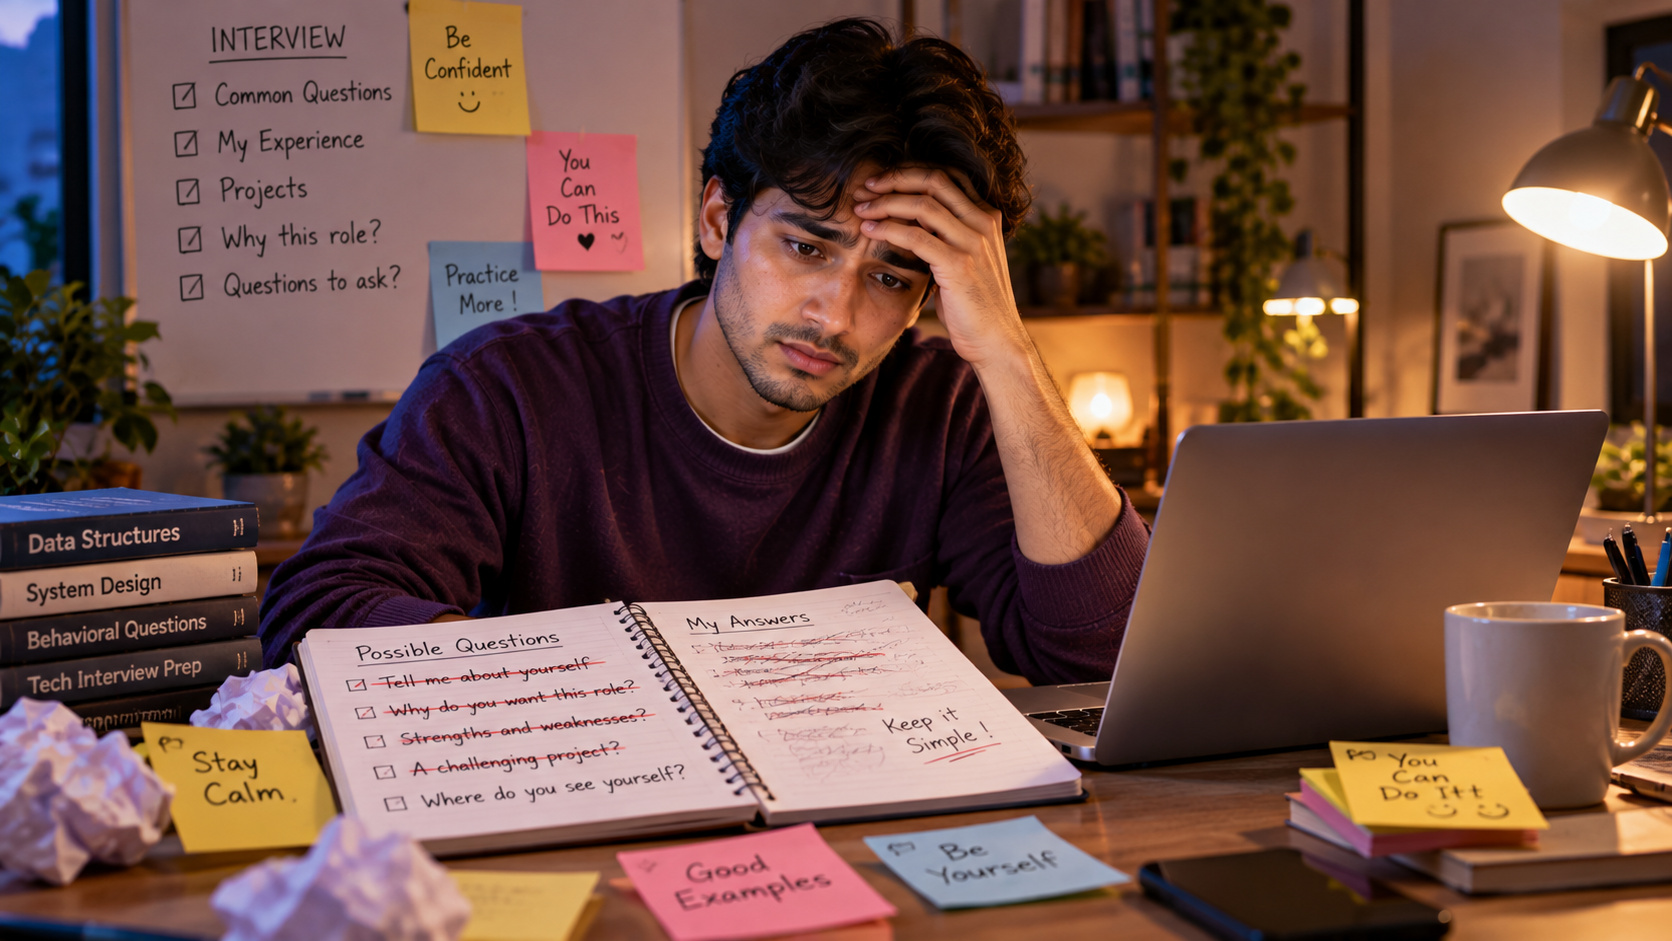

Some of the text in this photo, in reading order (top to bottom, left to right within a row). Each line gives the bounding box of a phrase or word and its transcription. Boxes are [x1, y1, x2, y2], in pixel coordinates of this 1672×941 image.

[211, 24, 346, 53] INTERVIEW
[445, 26, 472, 49] Be
[424, 57, 512, 81] Confident
[215, 80, 392, 107] Common Questions
[218, 129, 364, 162] My Experience
[559, 149, 590, 171] You
[220, 176, 308, 209] Projects
[561, 177, 596, 197] Can
[546, 205, 619, 226] Do This
[222, 218, 381, 257] Why this role?
[223, 265, 401, 299] Questions to ask?
[445, 263, 519, 287] Practice
[28, 527, 181, 554] Data Structures
[26, 574, 161, 606] System Design
[27, 622, 119, 649] Behavioral
[125, 614, 207, 640] Questions
[686, 611, 810, 634] My Answers
[356, 630, 560, 662] Possible Questions
[27, 659, 202, 694] Tech Interview Prep
[378, 657, 590, 689] Tell me about yourself
[389, 679, 634, 720] Why do you want this role?
[400, 709, 646, 746] Strengths and weaknesses?
[882, 715, 934, 736] Keep
[943, 707, 959, 723] it
[193, 752, 258, 778] Stay
[412, 740, 619, 776] A challenging project?
[1388, 753, 1437, 768] You
[421, 764, 684, 810] Where do you see yourself?
[1392, 771, 1449, 784] Can
[1380, 786, 1418, 800] Do
[939, 842, 989, 863] Be
[685, 854, 770, 885] Good
[925, 850, 1059, 886] Yourself
[675, 870, 832, 911] Examples
